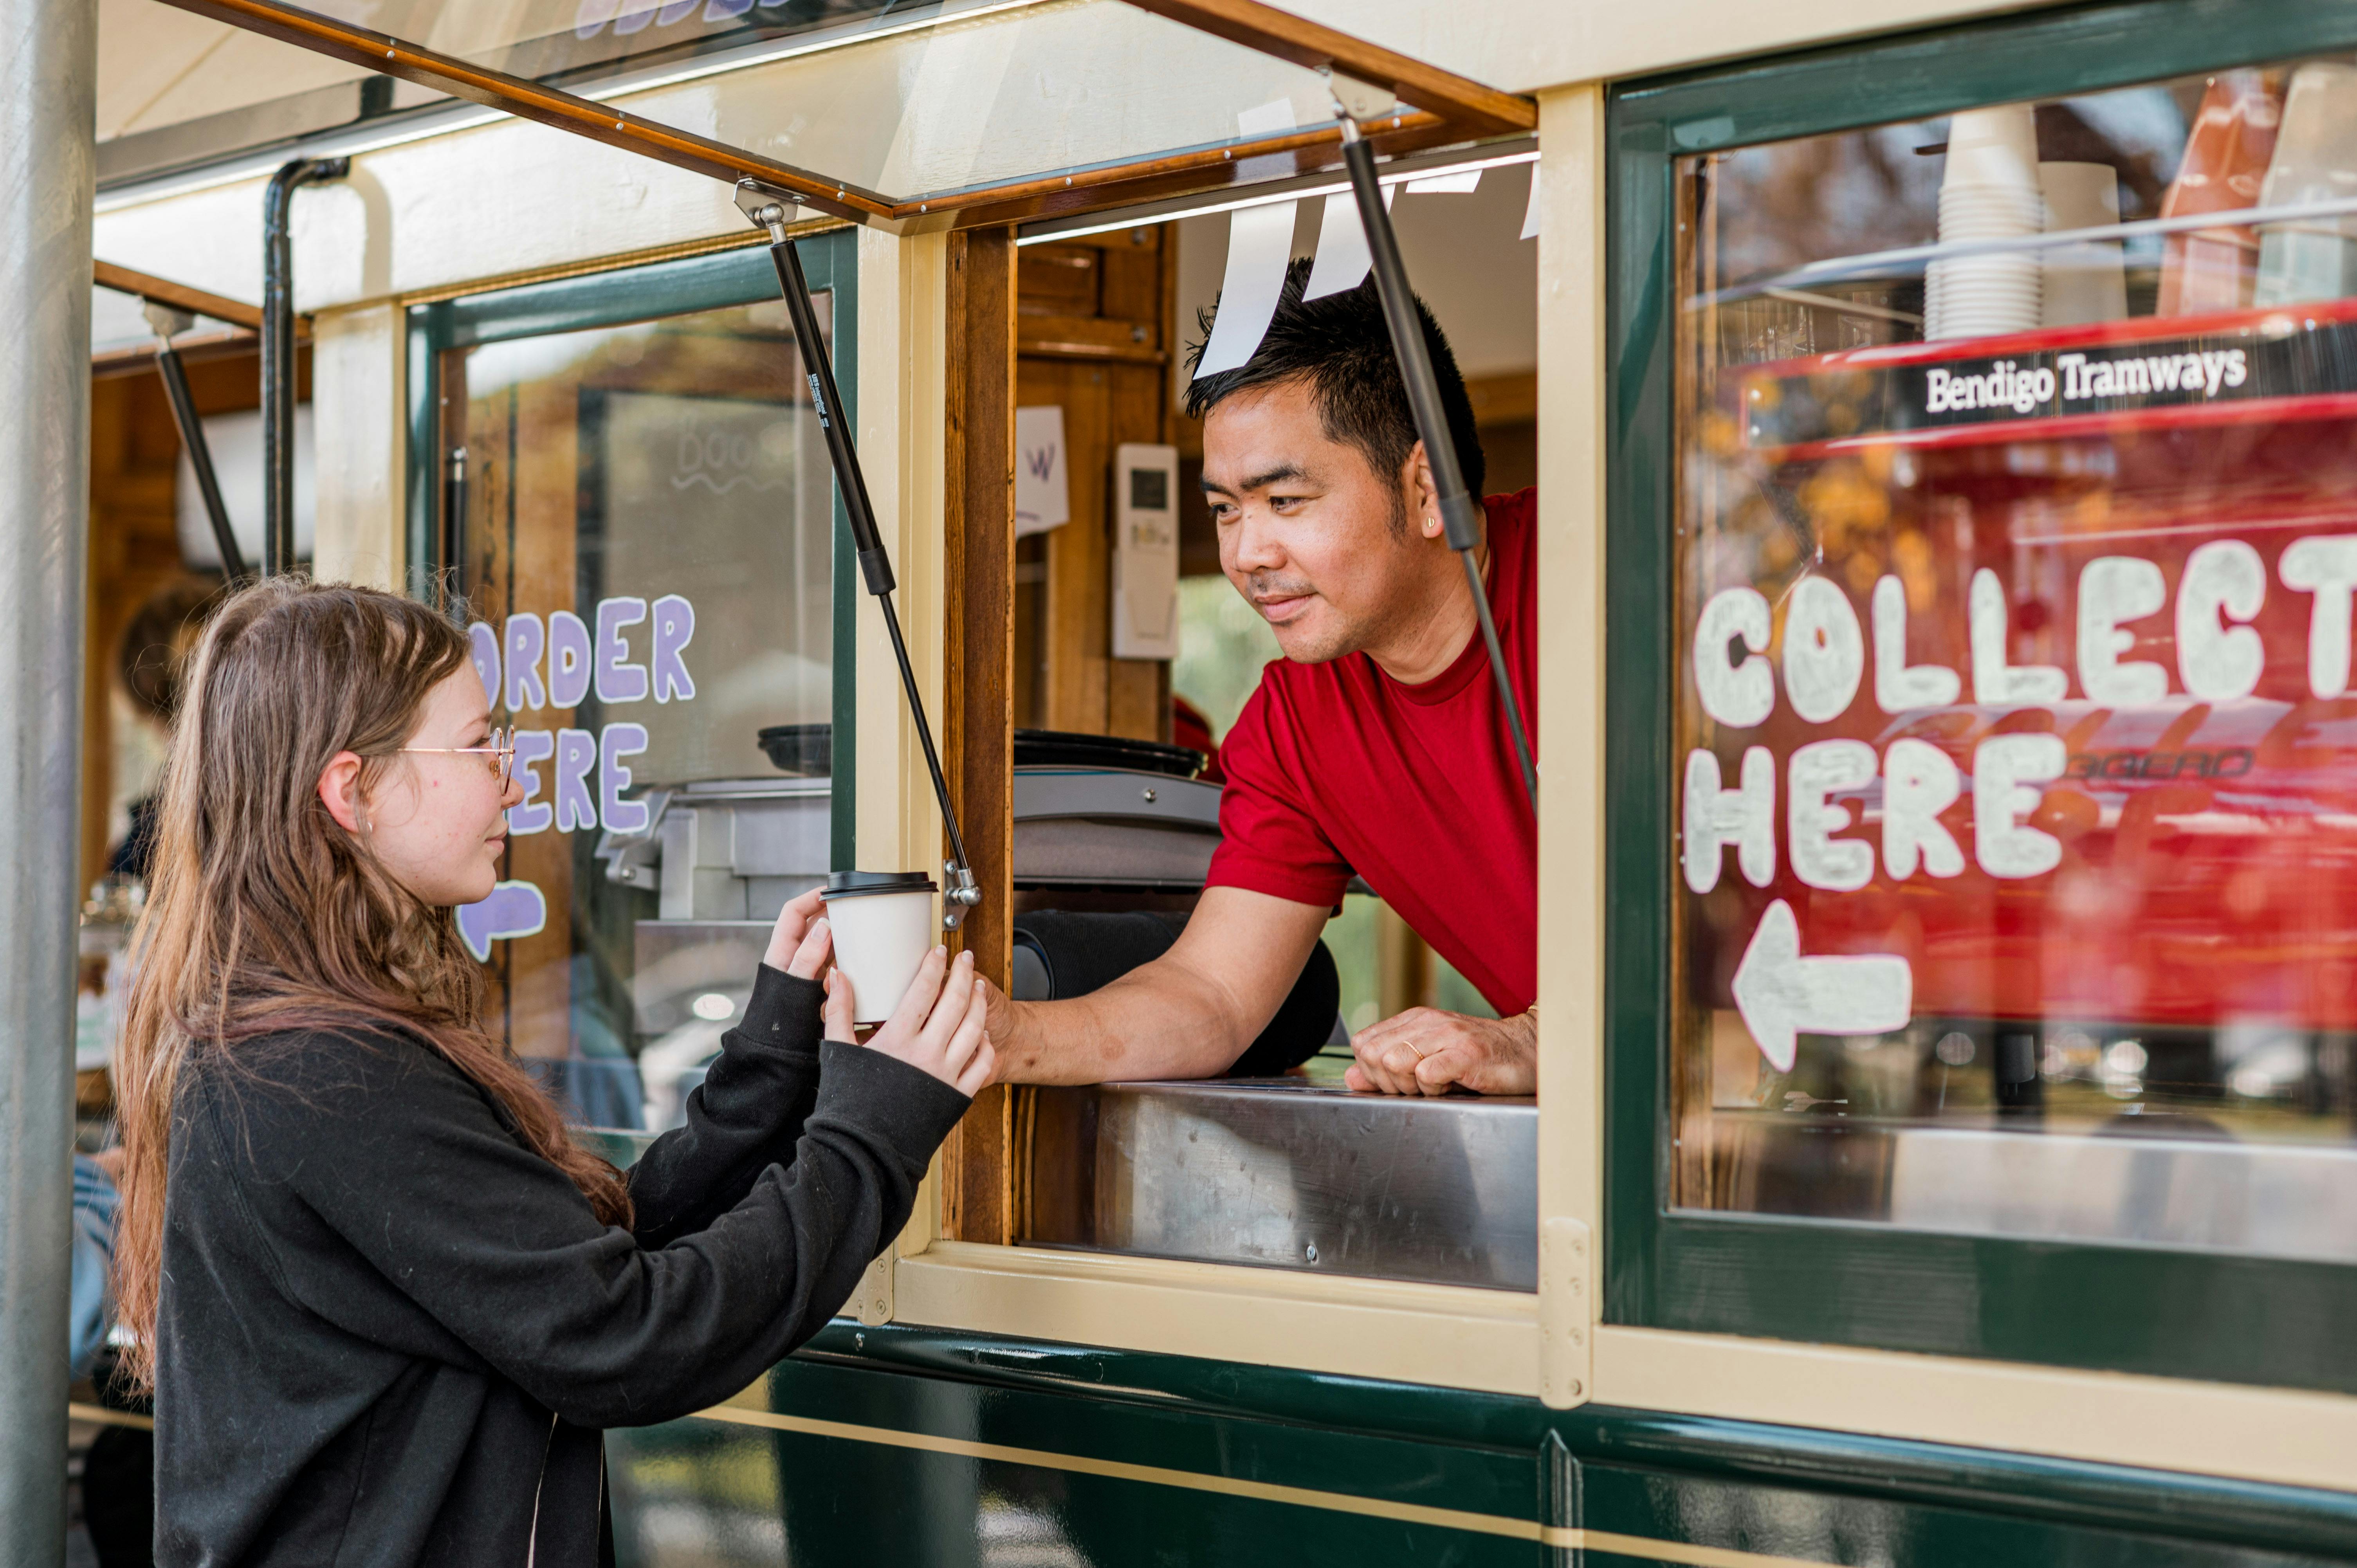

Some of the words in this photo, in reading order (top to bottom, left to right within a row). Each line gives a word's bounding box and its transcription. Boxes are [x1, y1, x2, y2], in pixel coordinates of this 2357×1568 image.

[1926, 360, 2055, 413] Bendigo
[2057, 349, 2247, 398] Tramways
[1693, 534, 2357, 728] COLLECT
[503, 723, 649, 835] ERE
[1683, 732, 2066, 894] HERE
